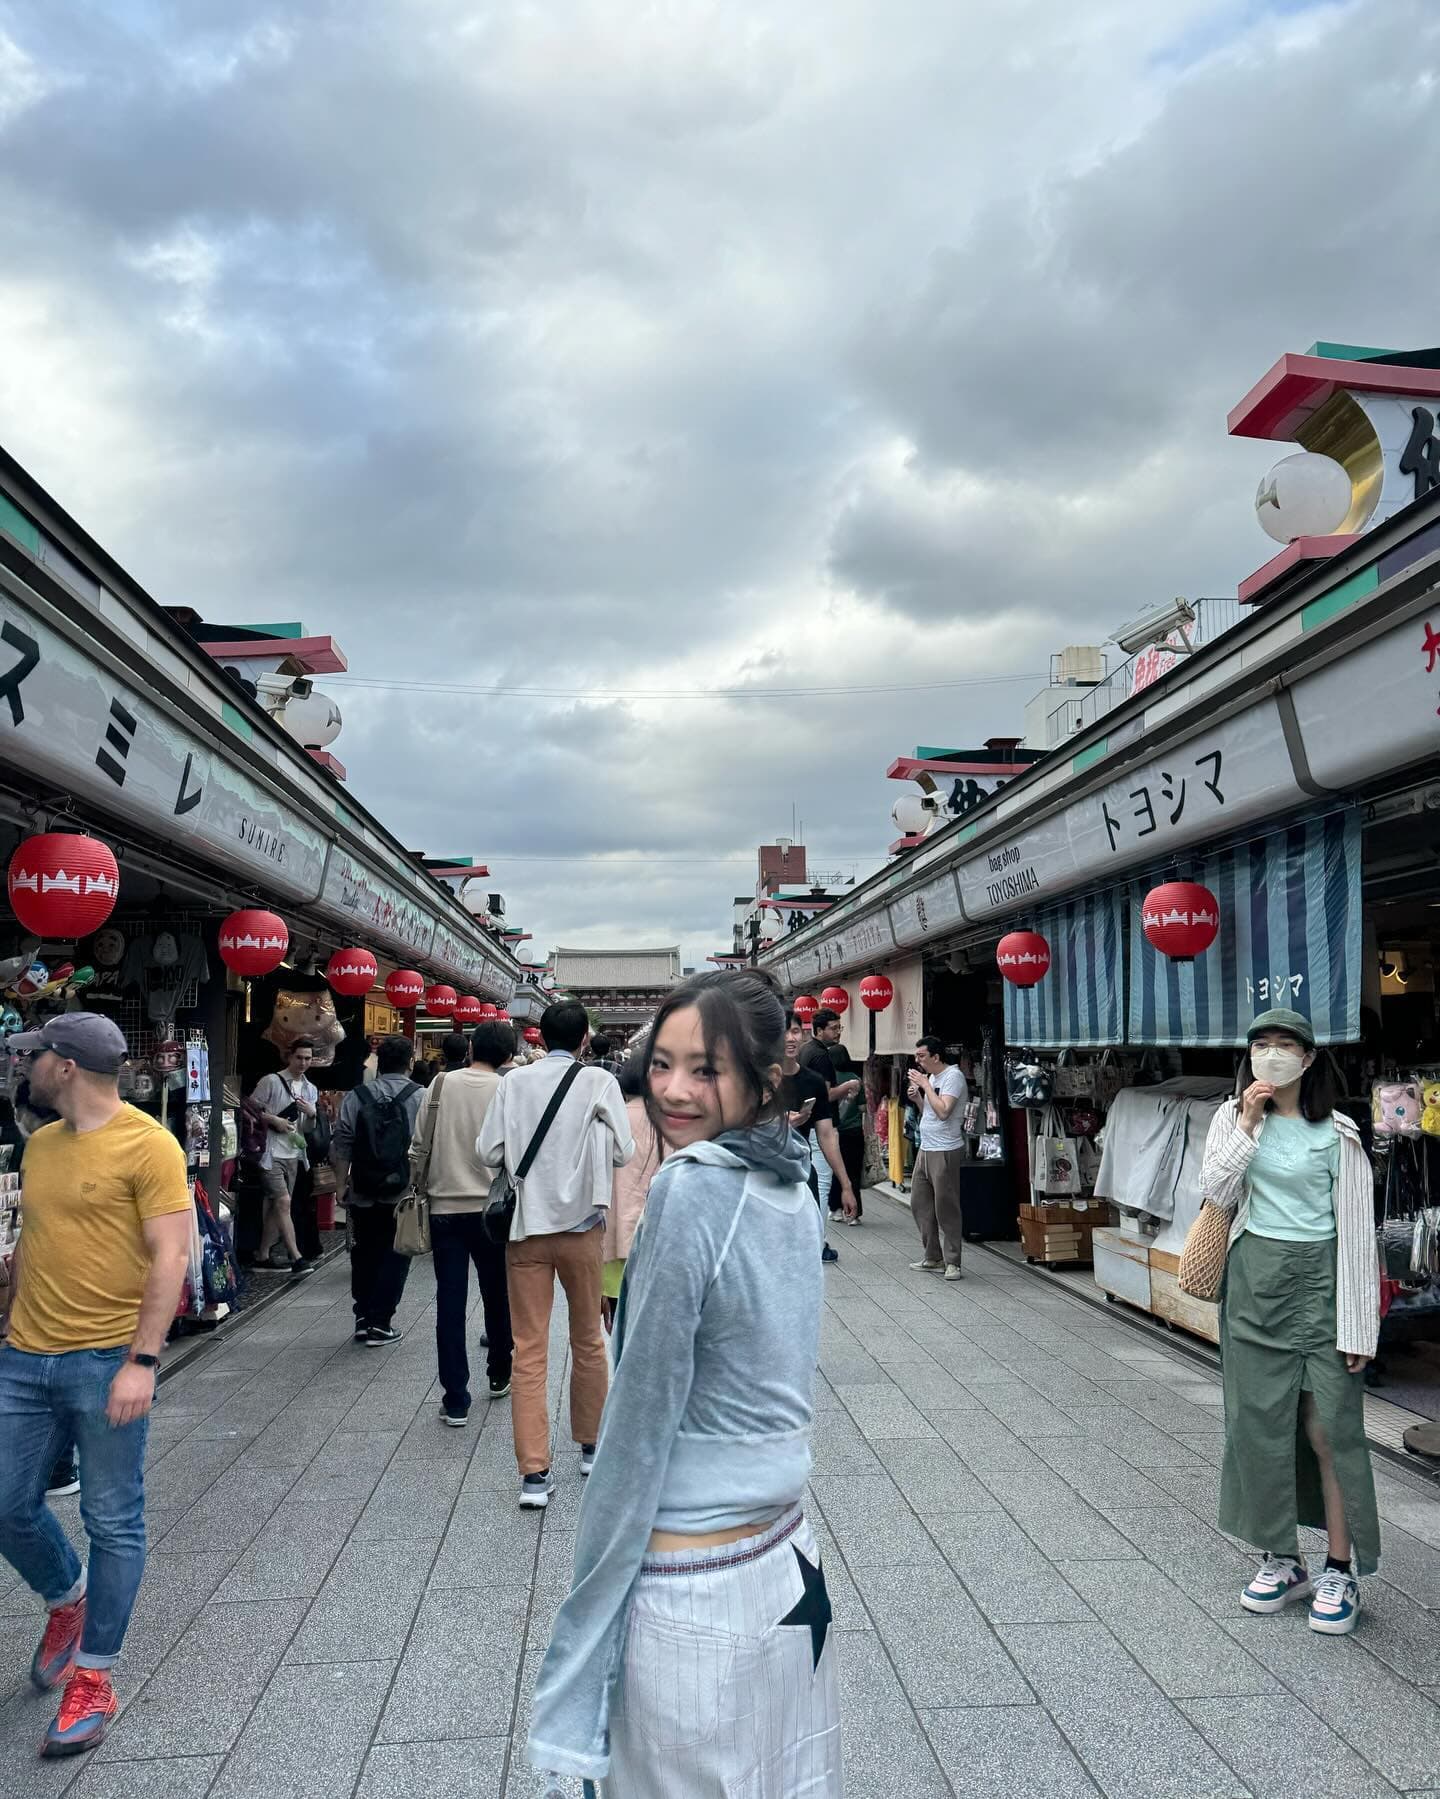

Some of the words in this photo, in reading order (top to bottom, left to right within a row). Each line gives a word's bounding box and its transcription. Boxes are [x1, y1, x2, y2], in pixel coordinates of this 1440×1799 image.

[0, 620, 202, 815] スミレ
[1102, 750, 1225, 851] トヨシマ
[238, 817, 286, 862] SUMIRE
[987, 855, 1003, 872] bag
[1002, 846, 1020, 867] shop
[986, 866, 1040, 906] TOYOSHIMA
[1245, 973, 1304, 1004] トヨシマ
